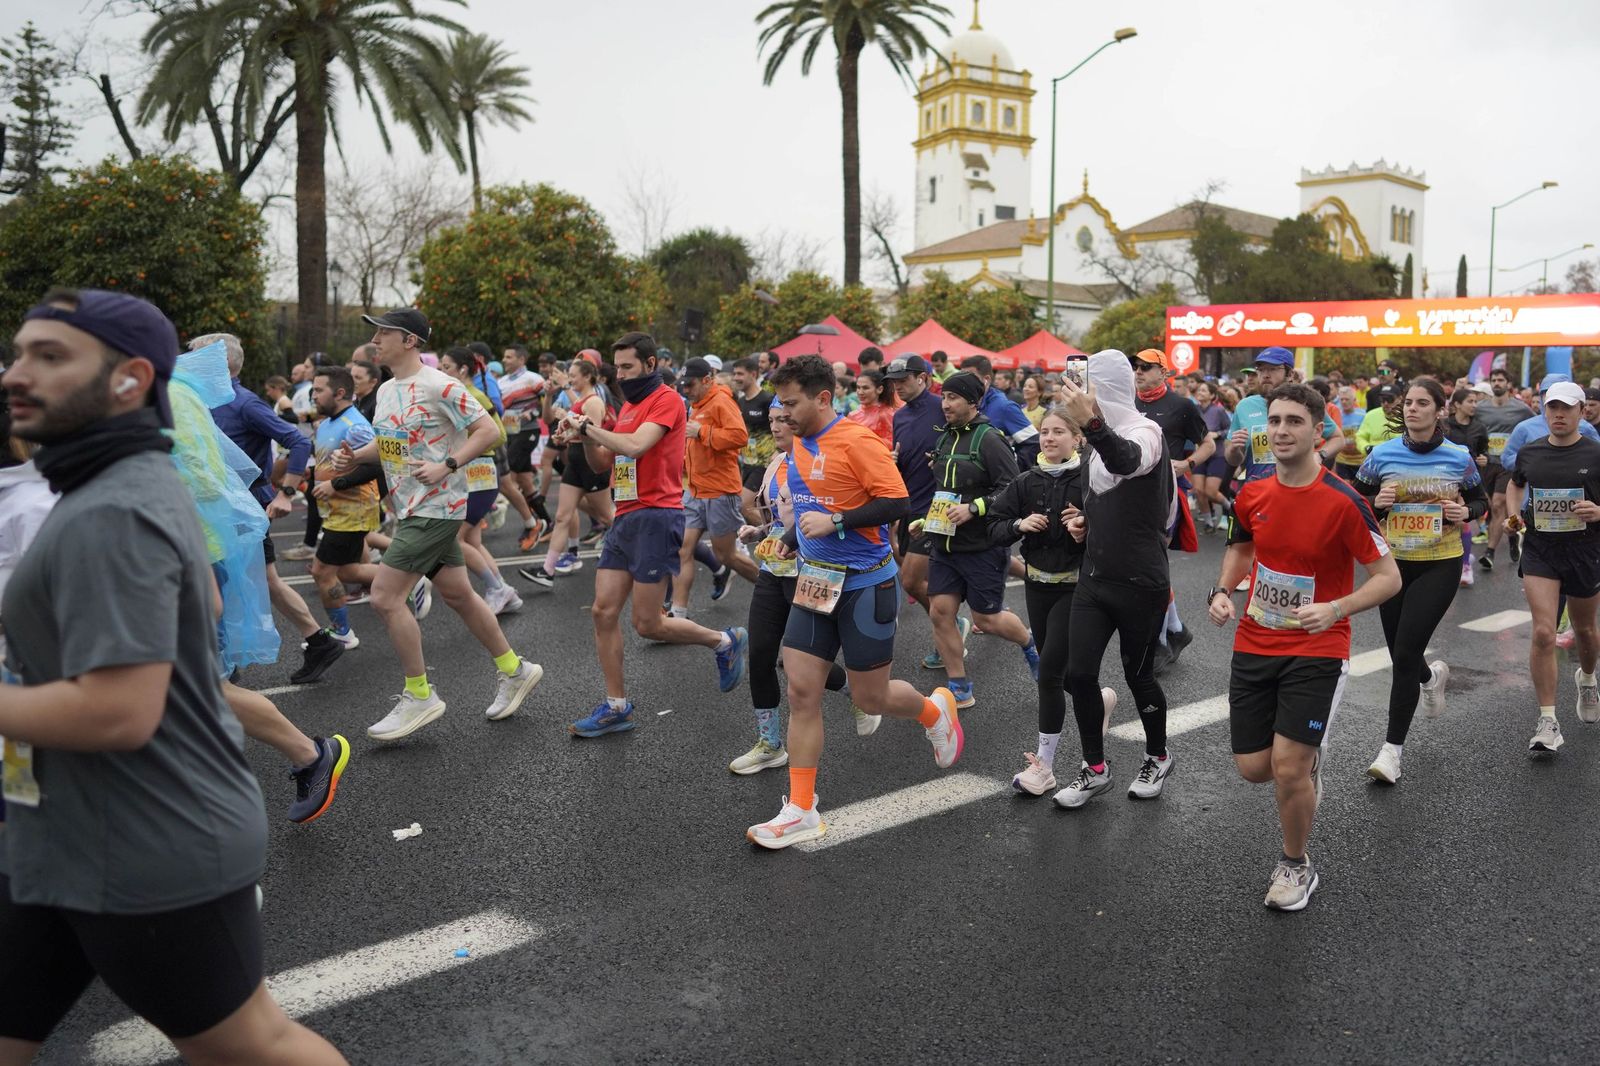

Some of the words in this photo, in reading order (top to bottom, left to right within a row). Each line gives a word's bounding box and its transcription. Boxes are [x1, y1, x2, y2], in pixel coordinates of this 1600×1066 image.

[1391, 515, 1434, 530] 17387
[800, 579, 829, 600] 4724
[1256, 580, 1301, 609] 20384
[1308, 720, 1323, 730] HH
